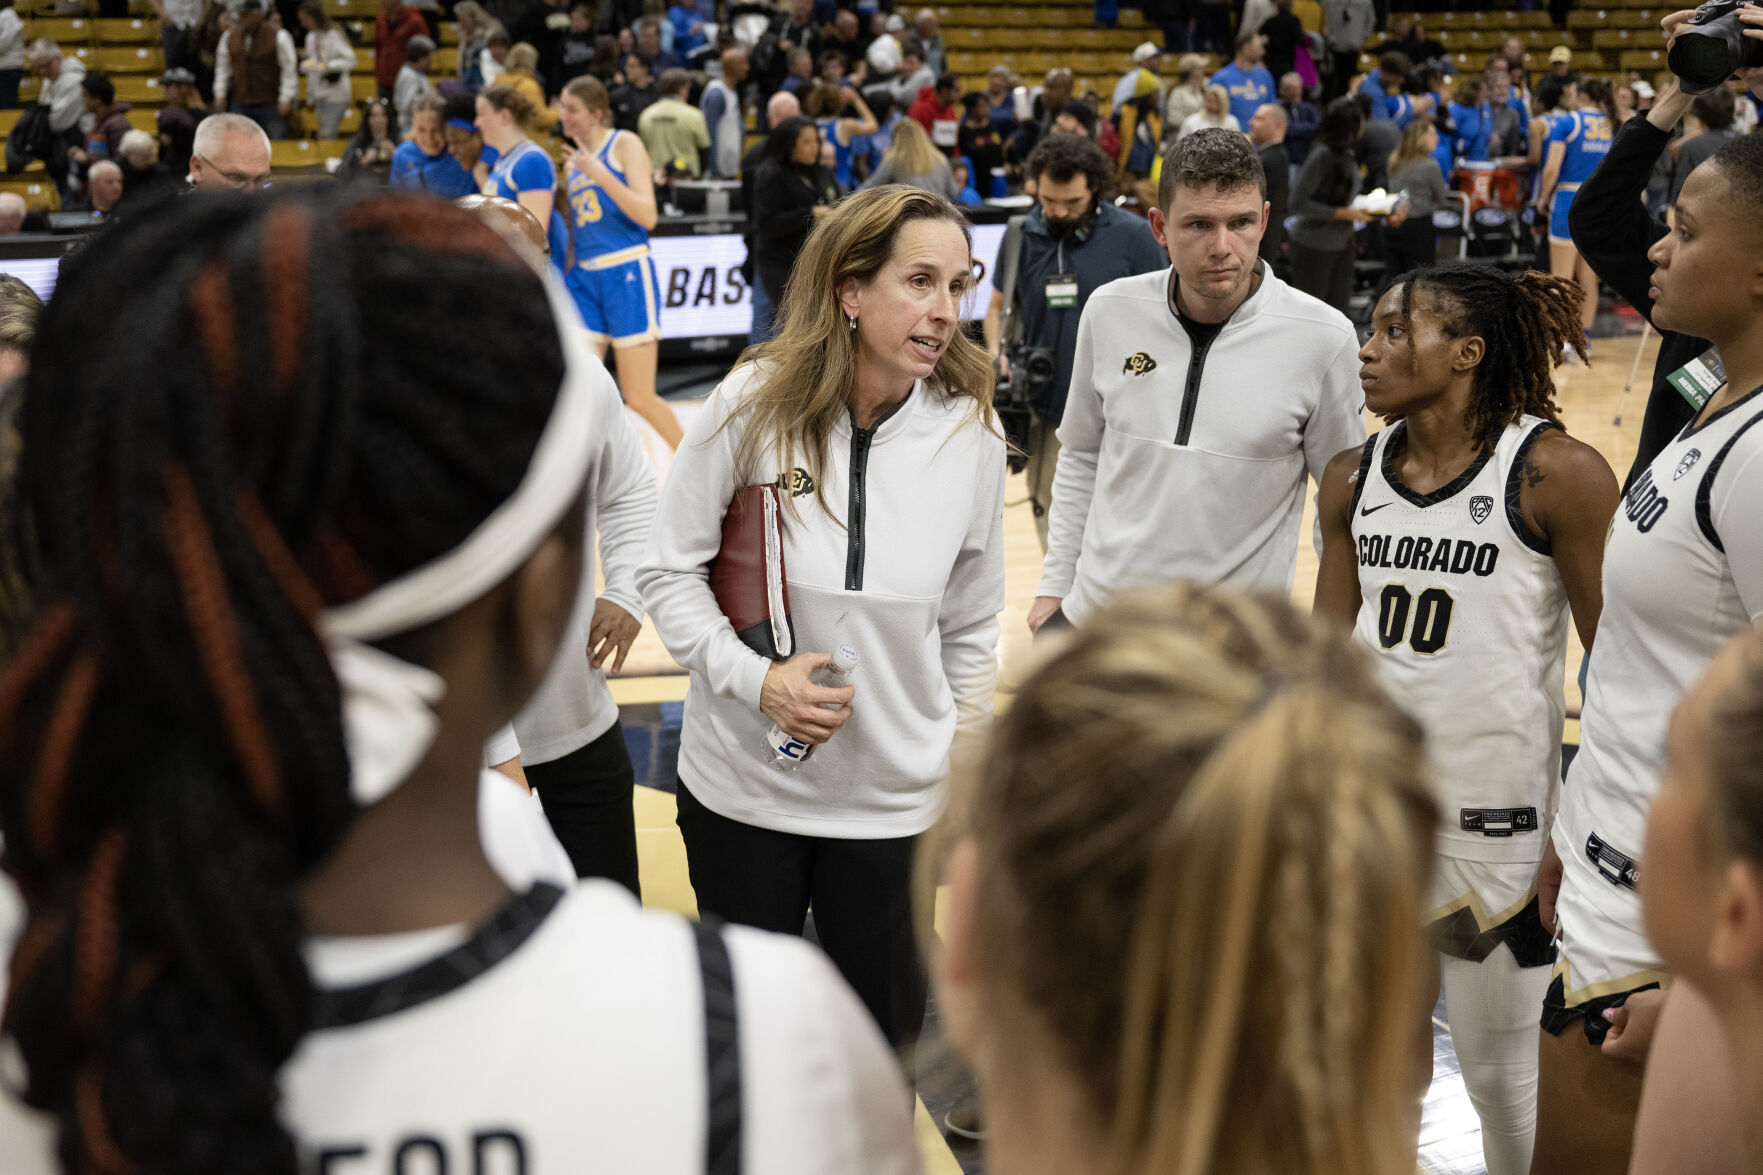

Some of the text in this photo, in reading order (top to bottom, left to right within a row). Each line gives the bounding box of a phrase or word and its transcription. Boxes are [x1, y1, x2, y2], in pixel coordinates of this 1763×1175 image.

[1677, 376, 1698, 397] MEDIA
[1358, 534, 1500, 578] COLORADO
[1379, 583, 1456, 656] 00
[1516, 814, 1528, 825] 42
[1625, 868, 1641, 882] 48
